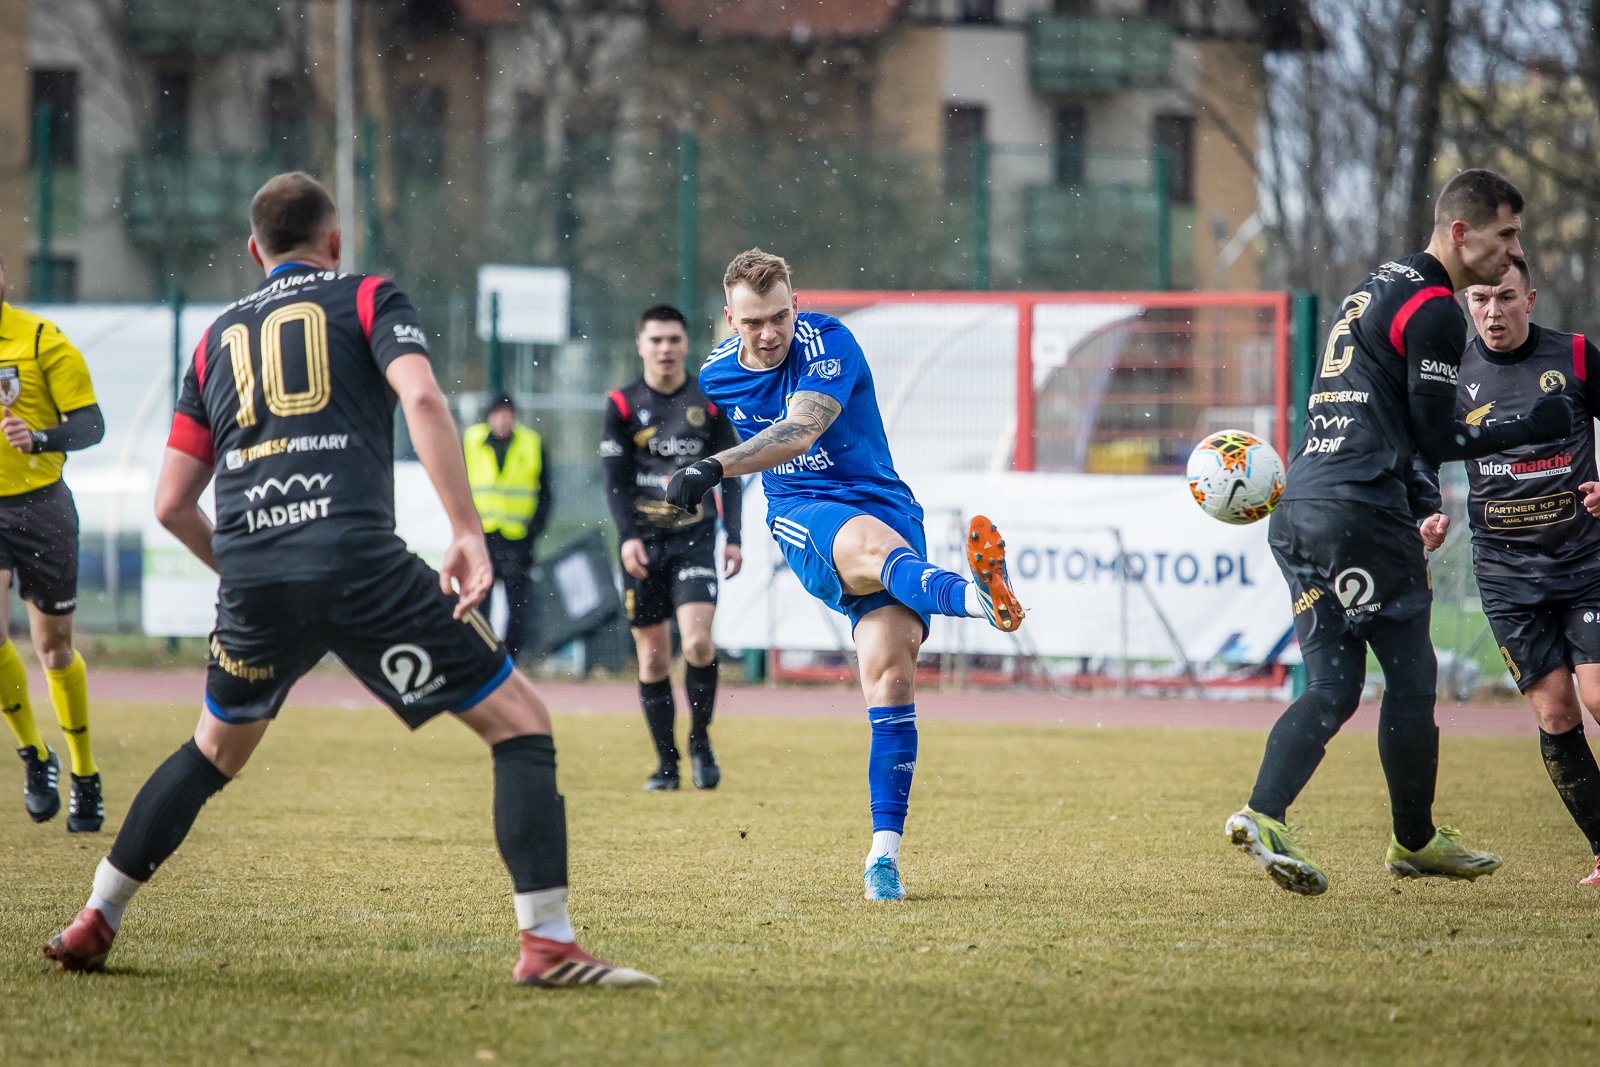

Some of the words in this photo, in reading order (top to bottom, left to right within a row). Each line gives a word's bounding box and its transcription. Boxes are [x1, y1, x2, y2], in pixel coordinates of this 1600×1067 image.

[1320, 290, 1372, 379] 2
[220, 301, 331, 428] 10
[246, 497, 332, 533] JADENT
[1488, 504, 1536, 514] PARTNER
[1540, 501, 1555, 510] KP
[1558, 497, 1572, 507] PK
[1016, 548, 1255, 587] OTOMOTO.PL
